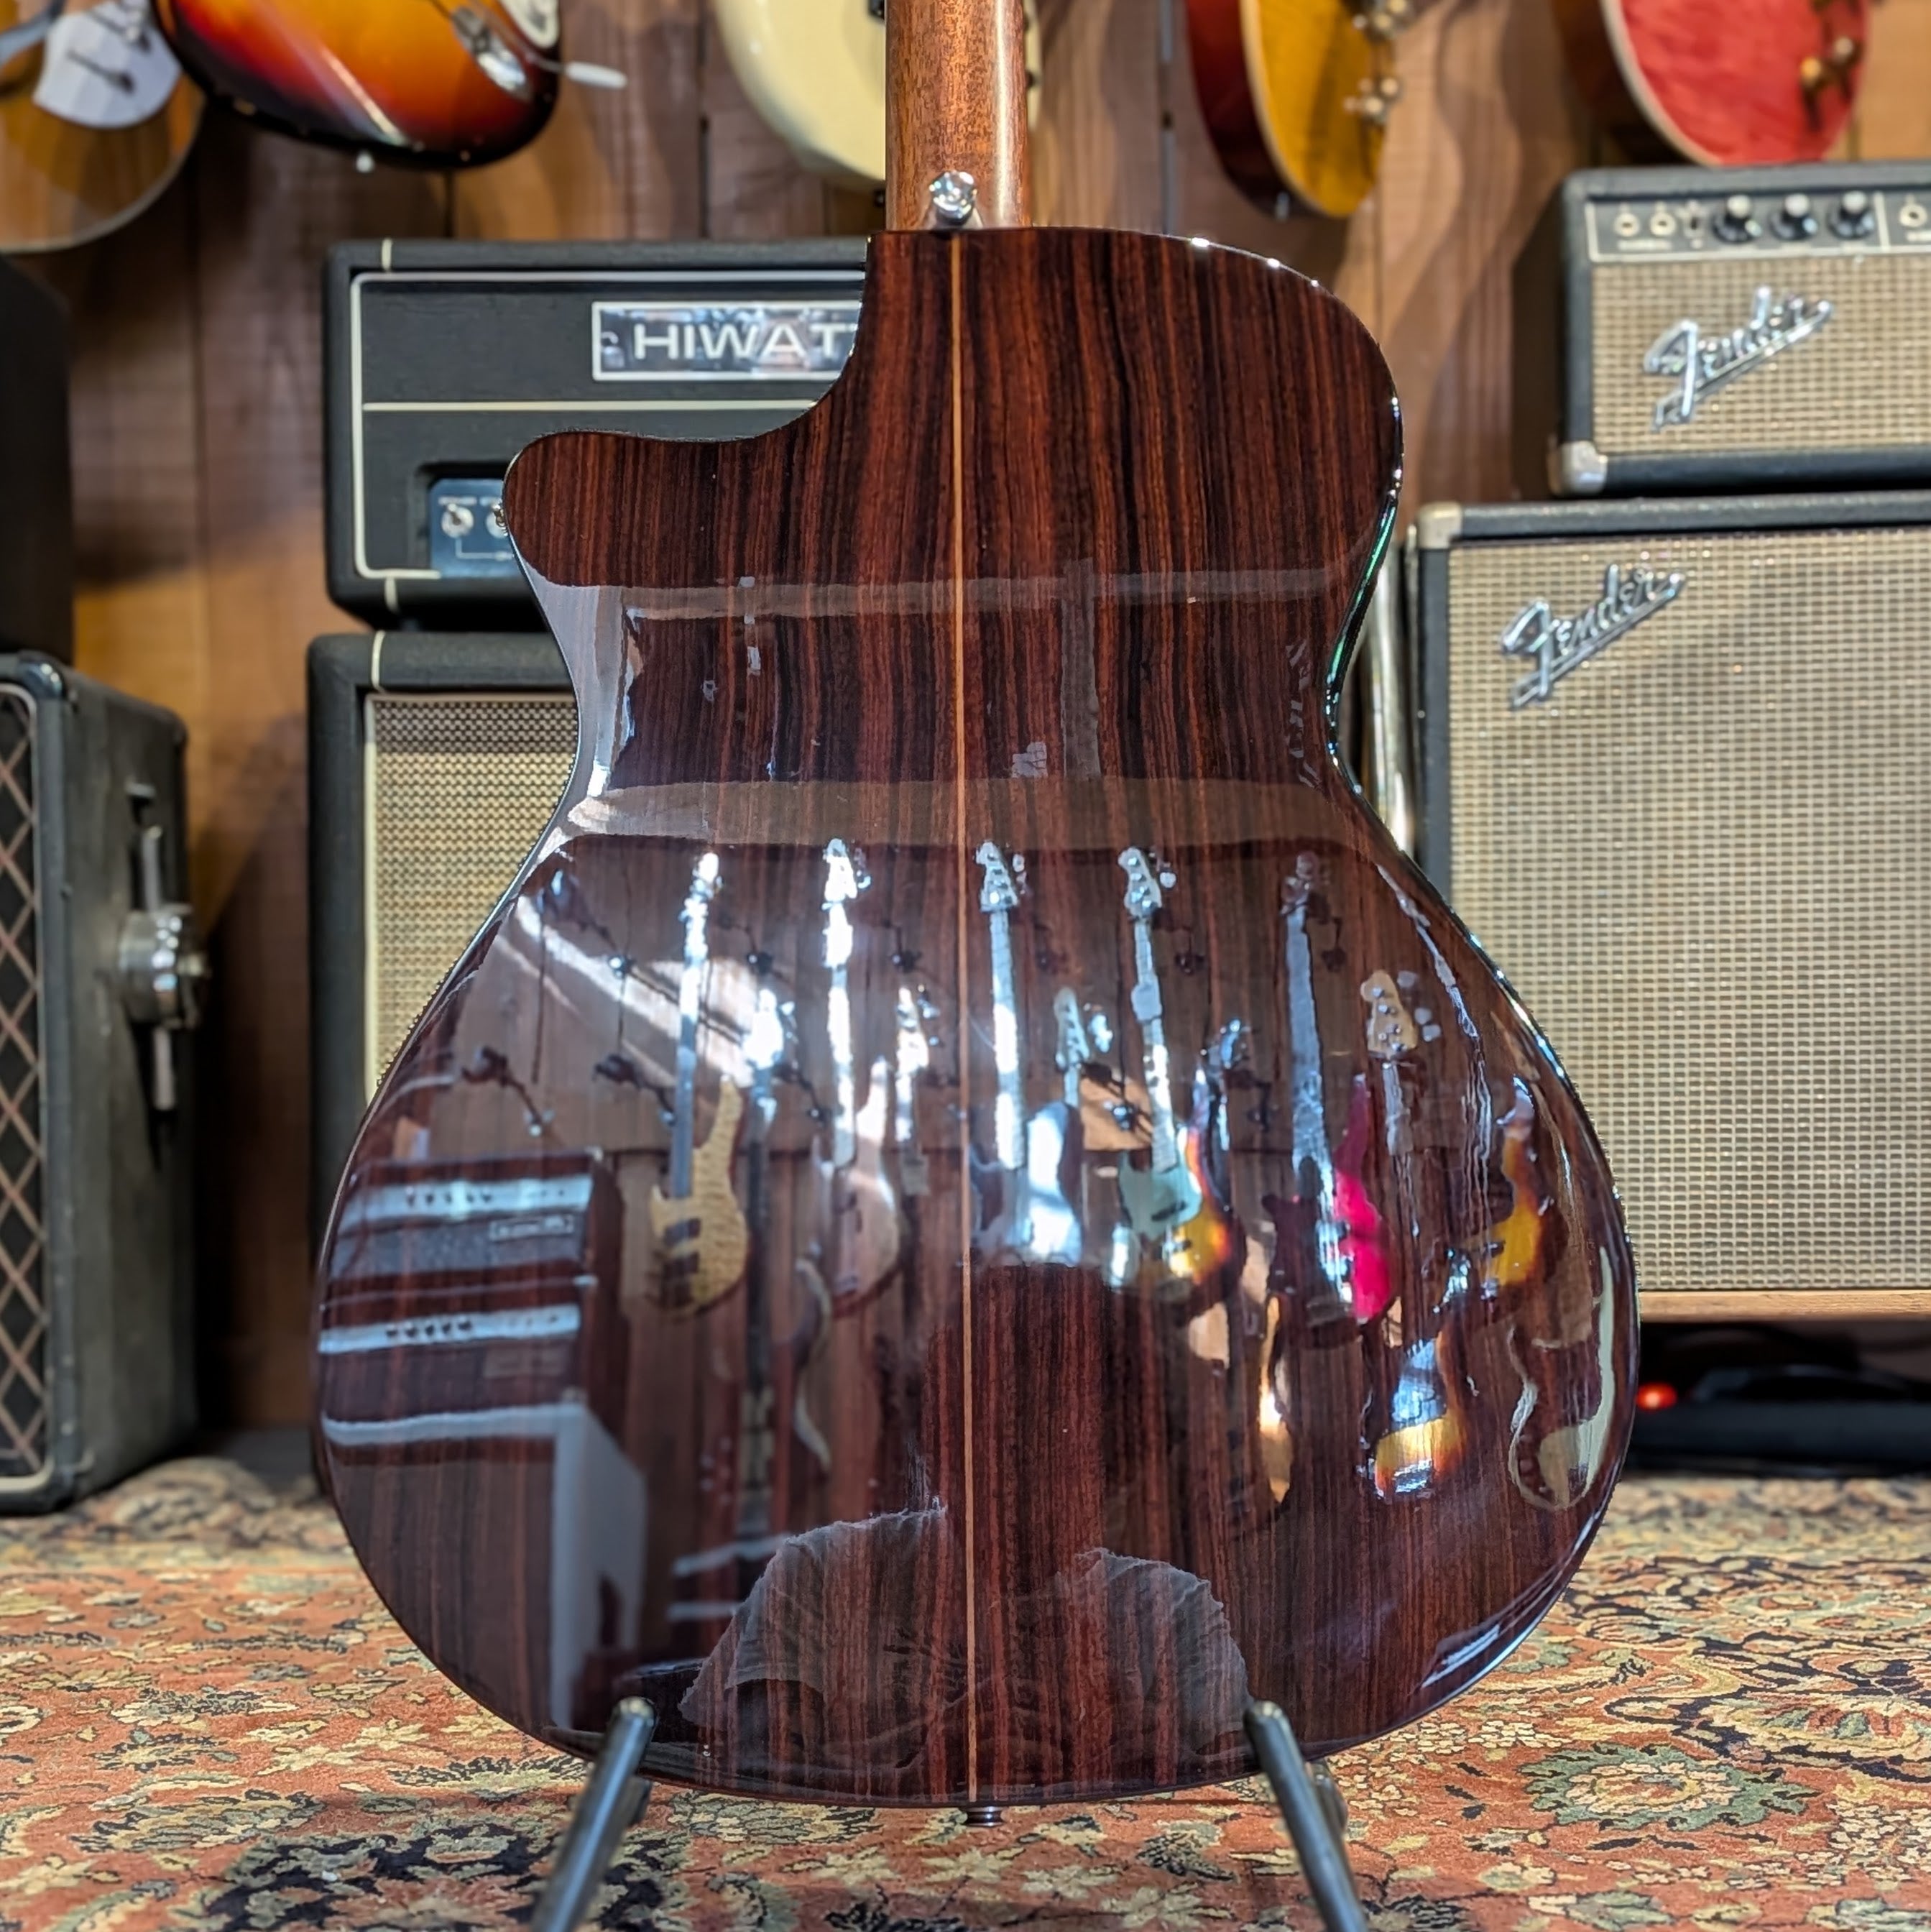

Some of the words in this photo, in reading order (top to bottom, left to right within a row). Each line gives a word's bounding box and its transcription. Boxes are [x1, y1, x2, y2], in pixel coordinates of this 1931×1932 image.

[633, 323, 859, 359] HIWAT
[1644, 285, 1833, 432] Fender
[1500, 562, 1685, 709] Fender
